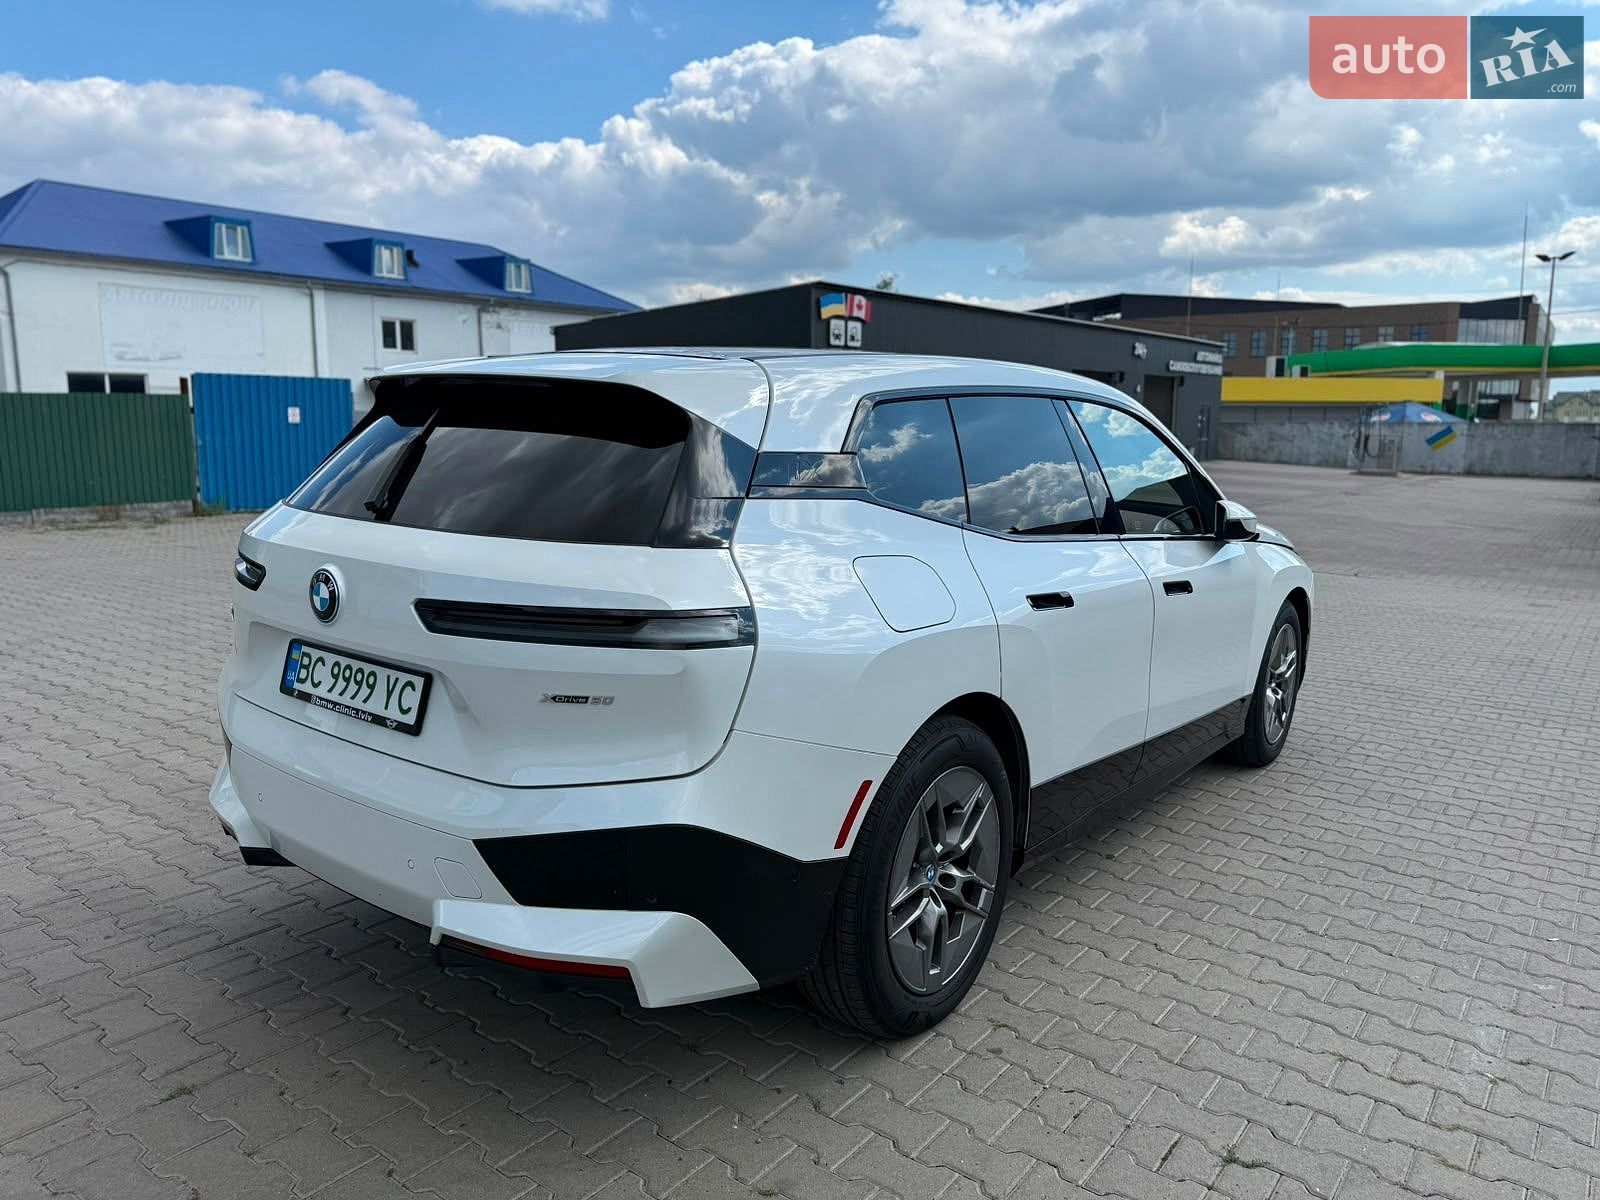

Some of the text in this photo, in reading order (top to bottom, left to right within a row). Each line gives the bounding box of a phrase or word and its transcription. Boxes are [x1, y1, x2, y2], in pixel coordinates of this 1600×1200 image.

[296, 651, 417, 716] BC 9999 YC
[310, 695, 373, 722] @bmw.clinic.lviv
